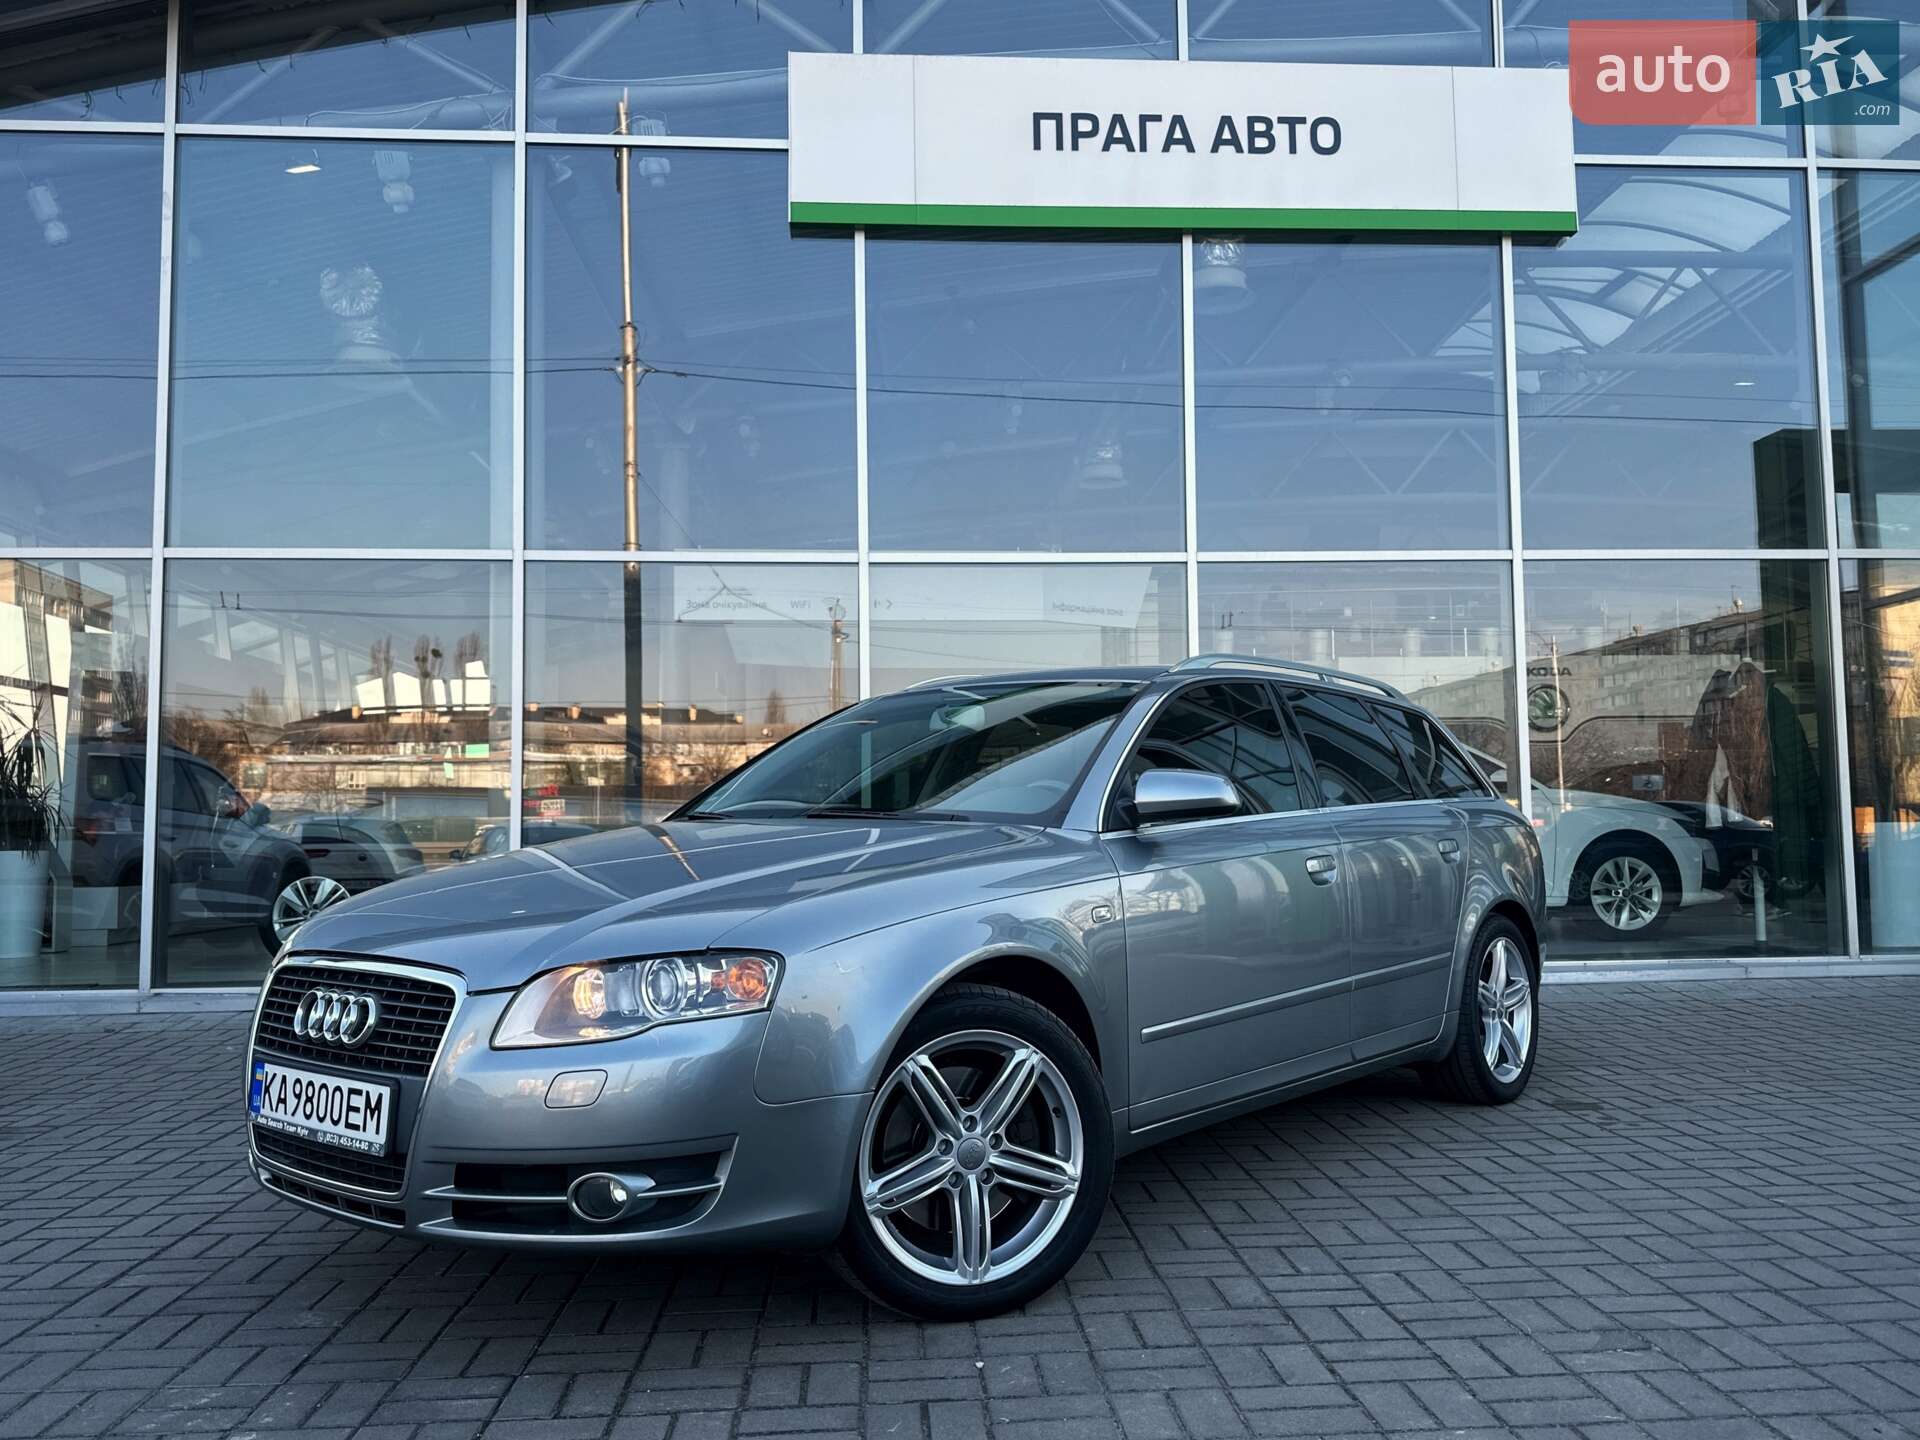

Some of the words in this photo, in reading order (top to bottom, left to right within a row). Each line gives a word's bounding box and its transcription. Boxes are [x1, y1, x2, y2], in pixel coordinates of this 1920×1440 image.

[1032, 112, 1196, 153] ПРАГА
[1210, 115, 1342, 155] АВТО
[1527, 667, 1572, 676] KODA
[262, 1071, 383, 1135] KA9800EM
